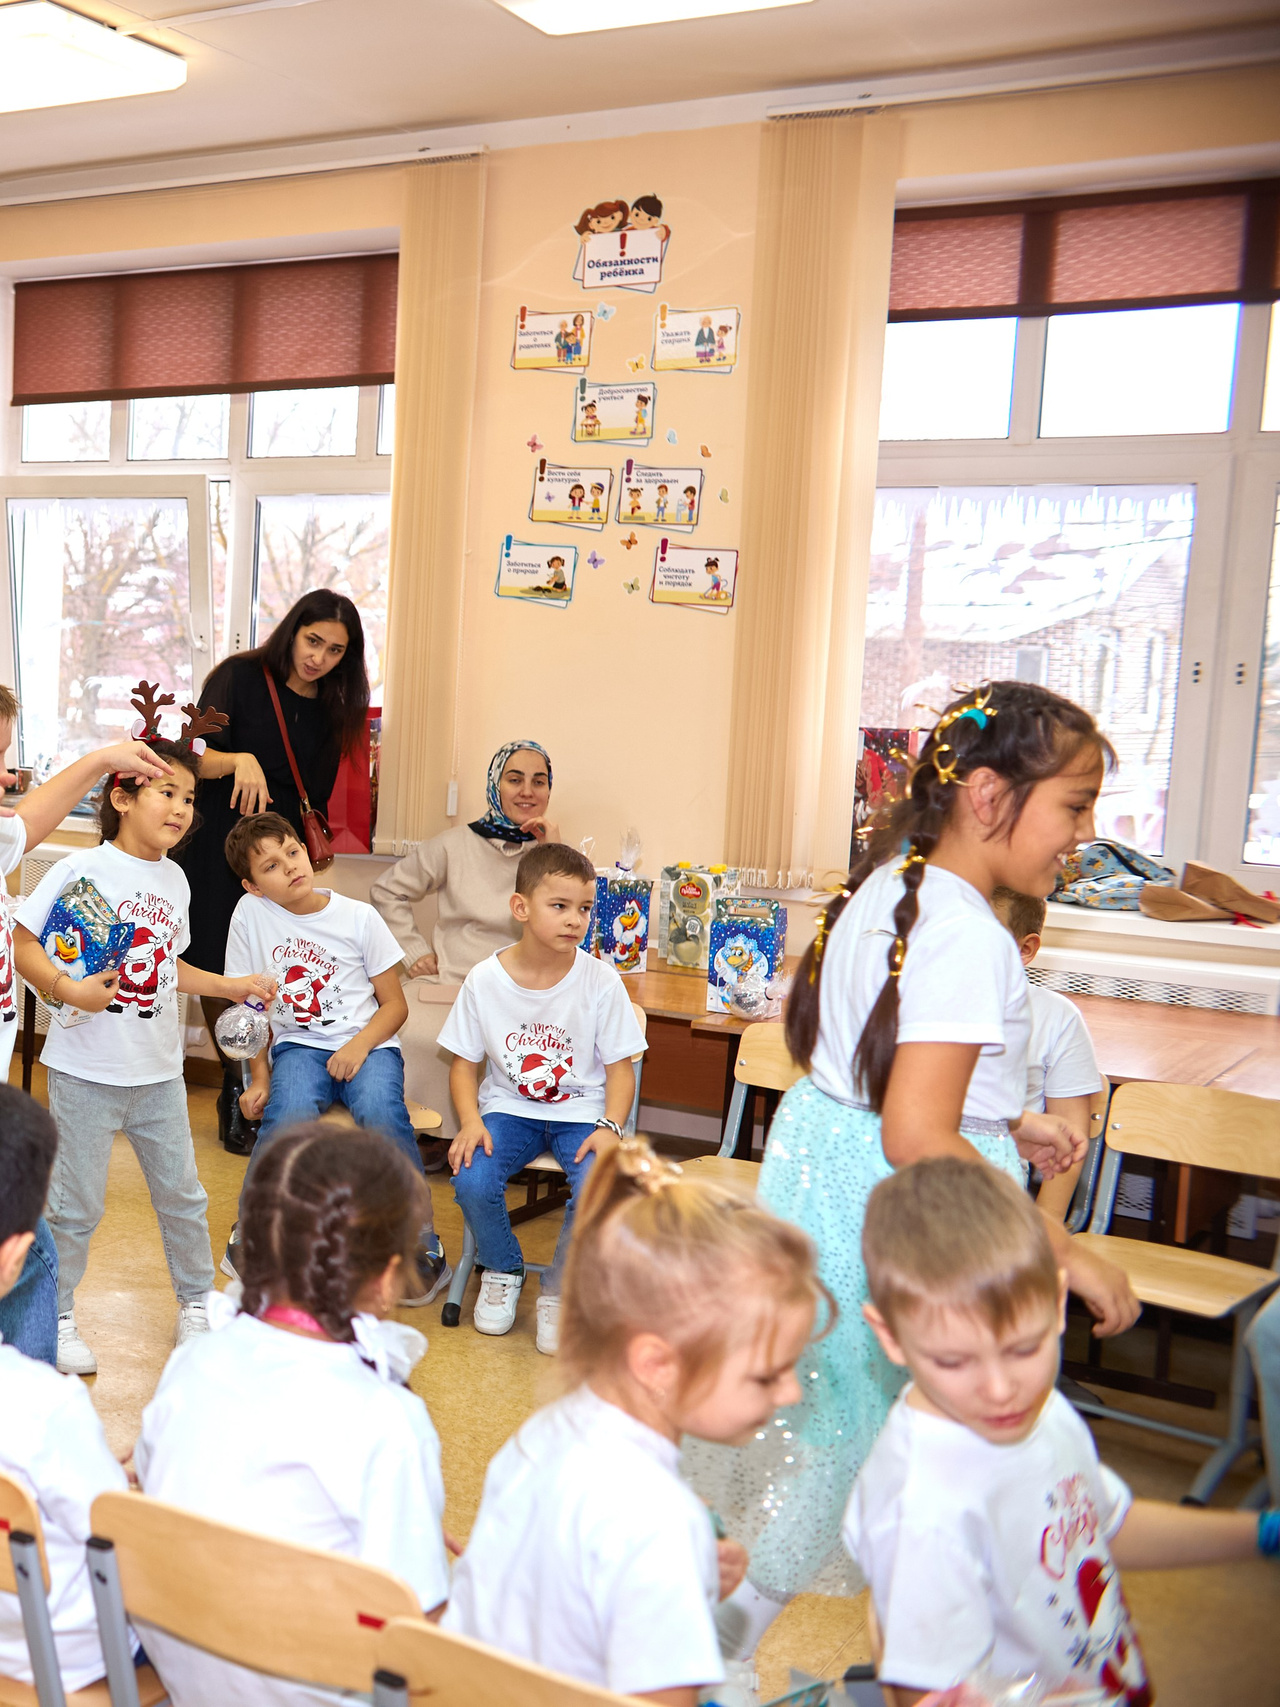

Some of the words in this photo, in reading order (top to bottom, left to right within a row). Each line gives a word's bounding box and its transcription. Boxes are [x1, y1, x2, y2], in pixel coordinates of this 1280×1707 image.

[587, 255, 659, 269] Обязанности
[600, 267, 644, 280] ребёнка
[660, 337, 691, 345] старших
[598, 386, 649, 395] Добросовестно
[598, 394, 624, 402] учиться
[635, 470, 663, 478] Следить
[547, 476, 580, 484] культурно
[644, 477, 679, 485] здоровьем
[506, 560, 541, 568] Заботиться
[512, 567, 539, 575] природе
[658, 566, 696, 575] Соблюдать
[663, 573, 690, 581] чистоту
[664, 580, 693, 588] порядок
[144, 892, 175, 915] Merry
[293, 938, 327, 956] Merry
[272, 944, 340, 976] Christmas
[529, 1022, 566, 1039] Merry
